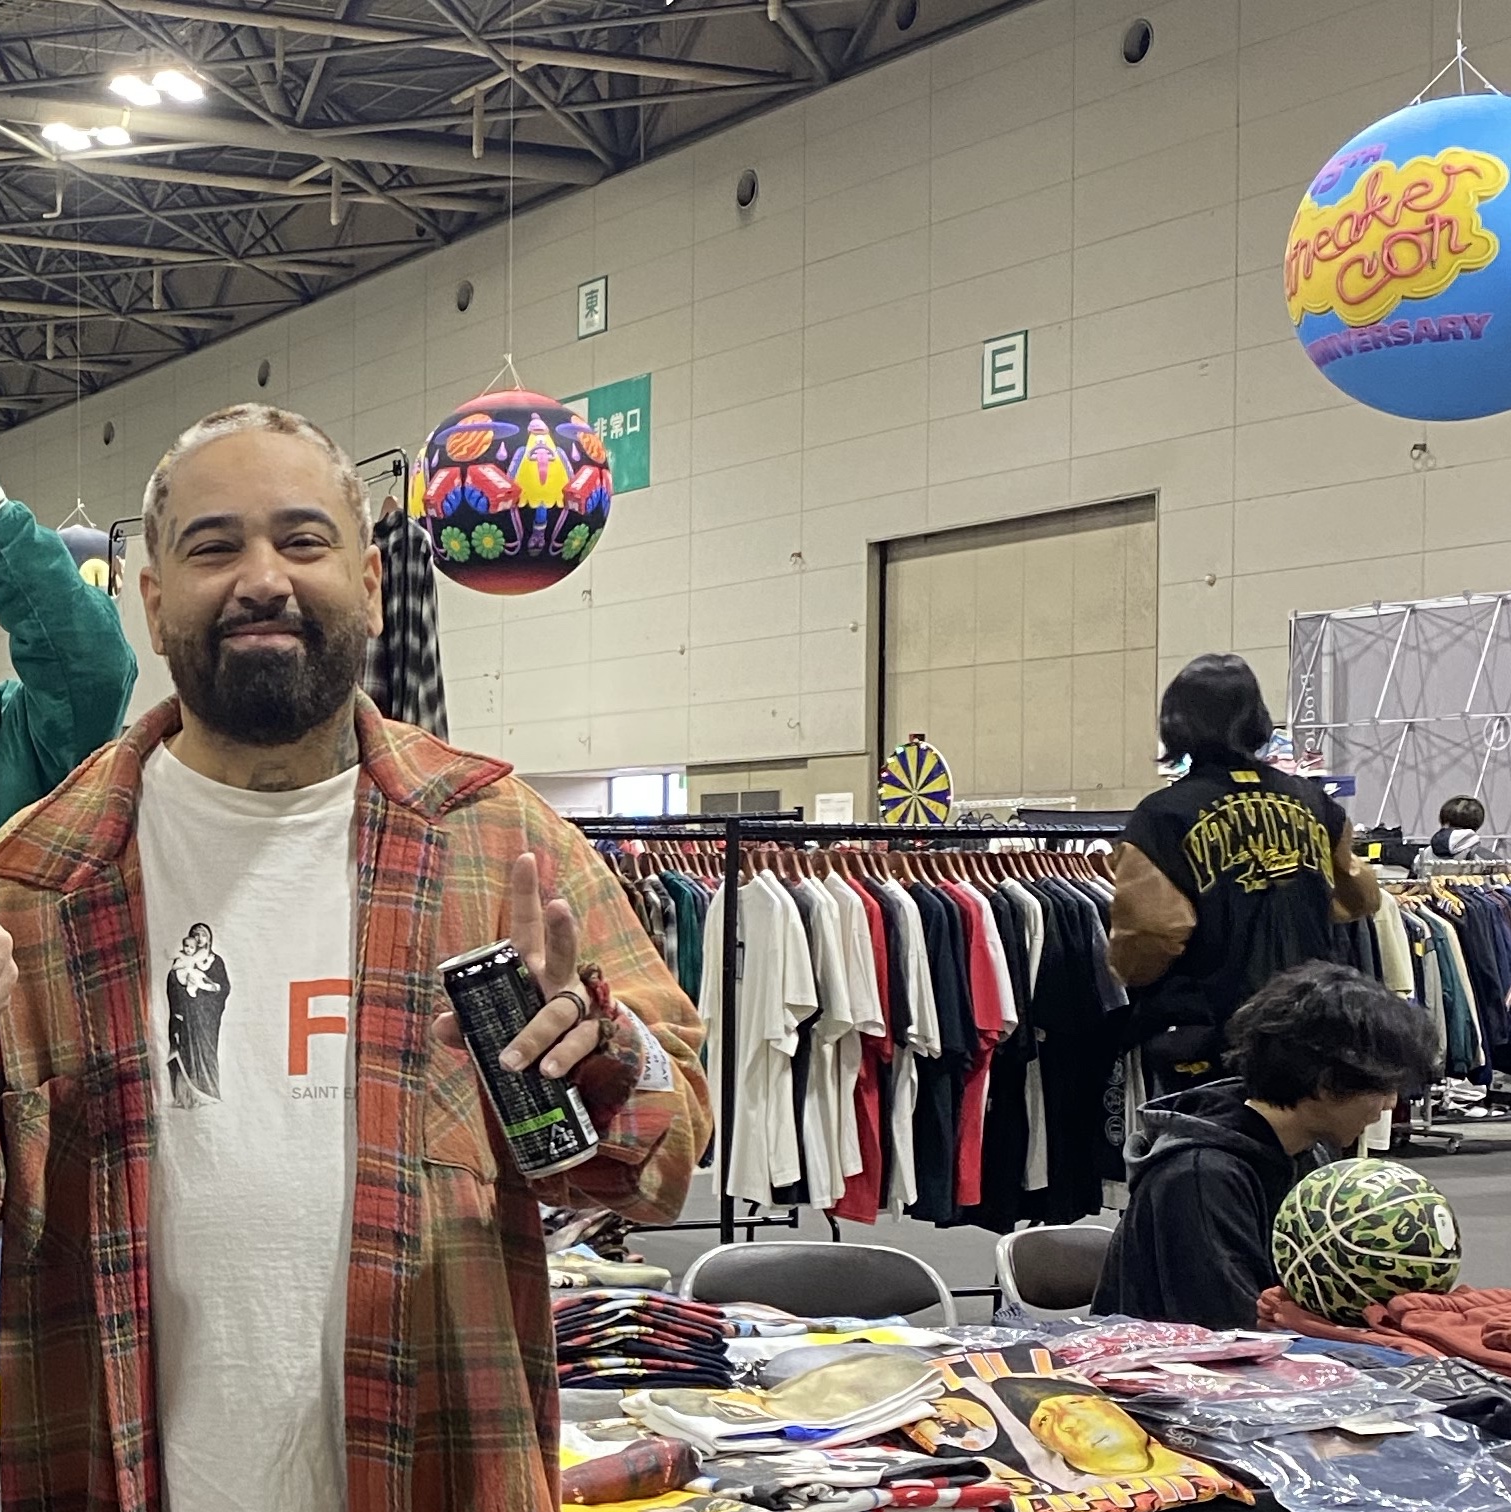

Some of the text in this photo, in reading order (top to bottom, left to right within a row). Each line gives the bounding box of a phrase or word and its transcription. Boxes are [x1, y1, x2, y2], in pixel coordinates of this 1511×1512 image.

[585, 290, 600, 318] 東
[991, 343, 1017, 396] E
[291, 1086, 339, 1100] SAINT
